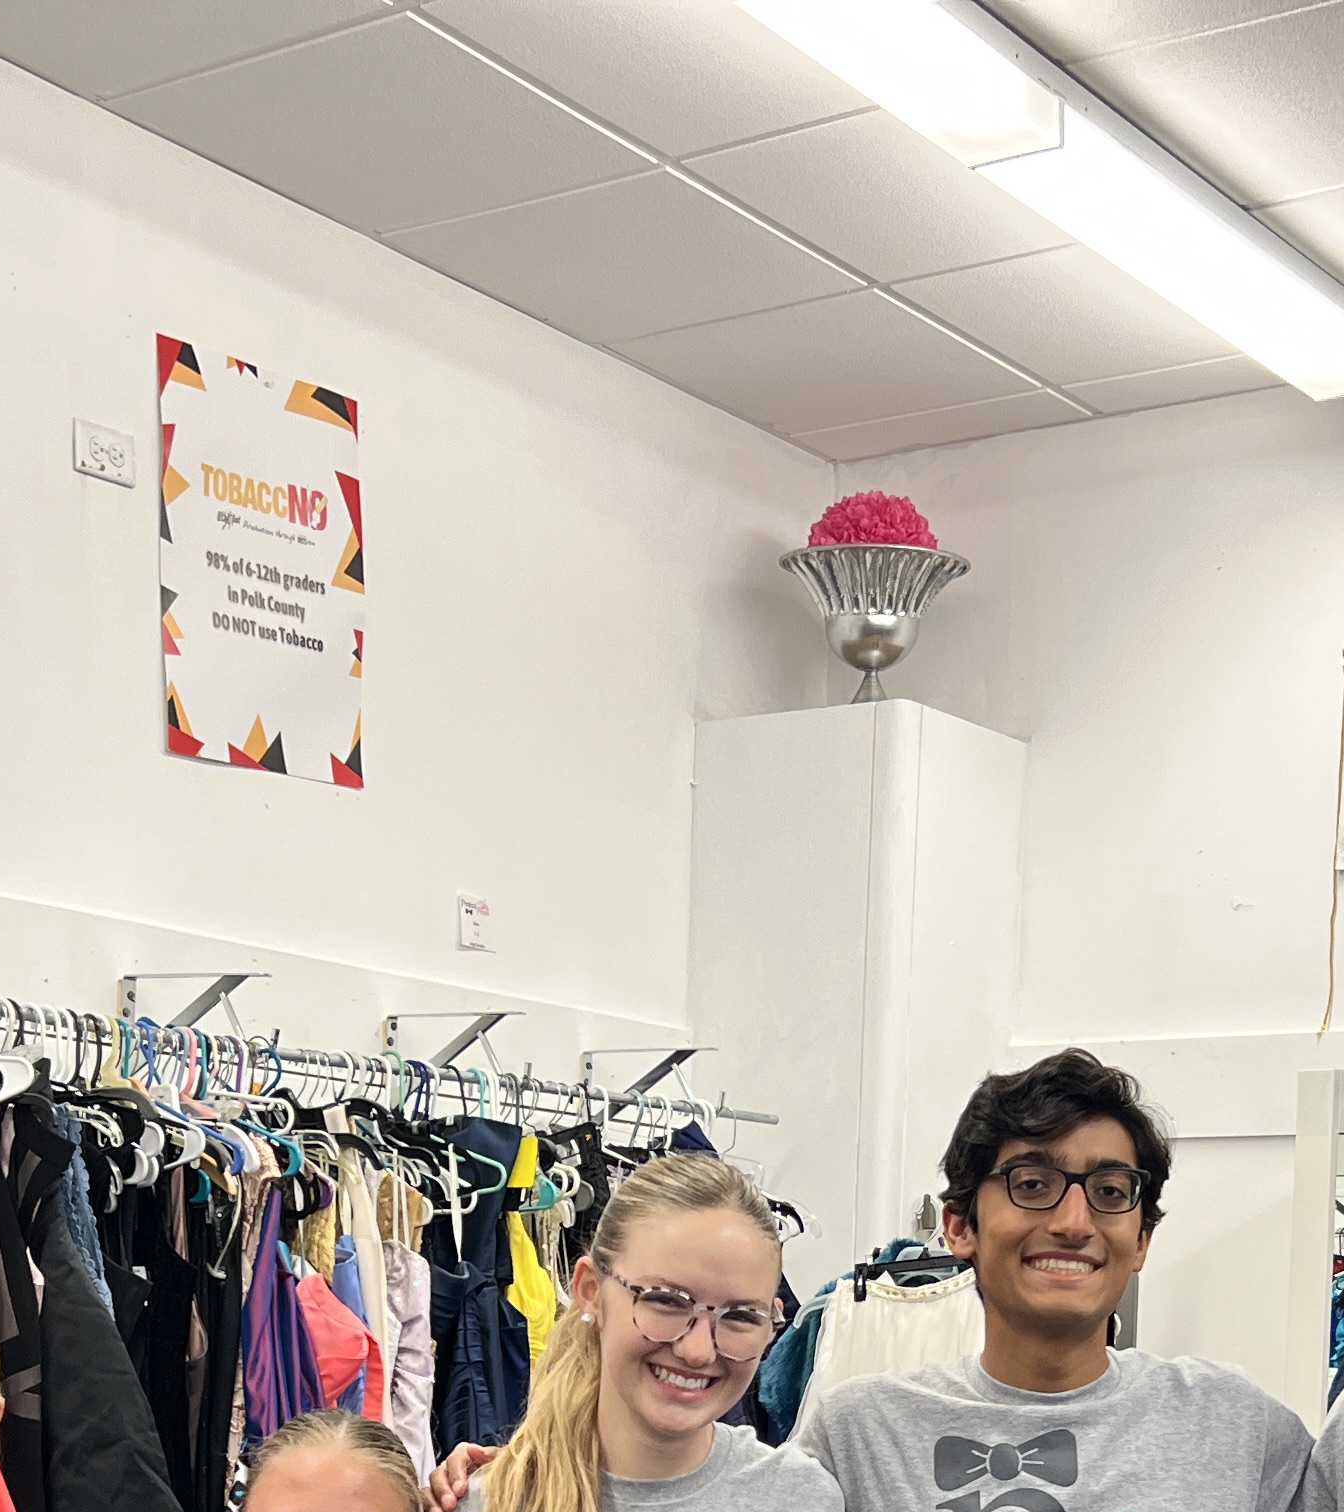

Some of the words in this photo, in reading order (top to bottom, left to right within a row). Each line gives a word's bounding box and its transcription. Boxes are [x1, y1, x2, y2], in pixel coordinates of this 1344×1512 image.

[206, 551, 230, 572] 98%
[232, 558, 244, 575] of
[246, 562, 281, 584] 6-12th
[283, 574, 325, 595] graders
[227, 584, 239, 604] in
[241, 589, 266, 610] Polk
[268, 596, 305, 623] County
[212, 611, 230, 631] DO
[232, 616, 257, 637] NOT
[259, 625, 277, 641] use
[278, 626, 324, 652] Tobacco
